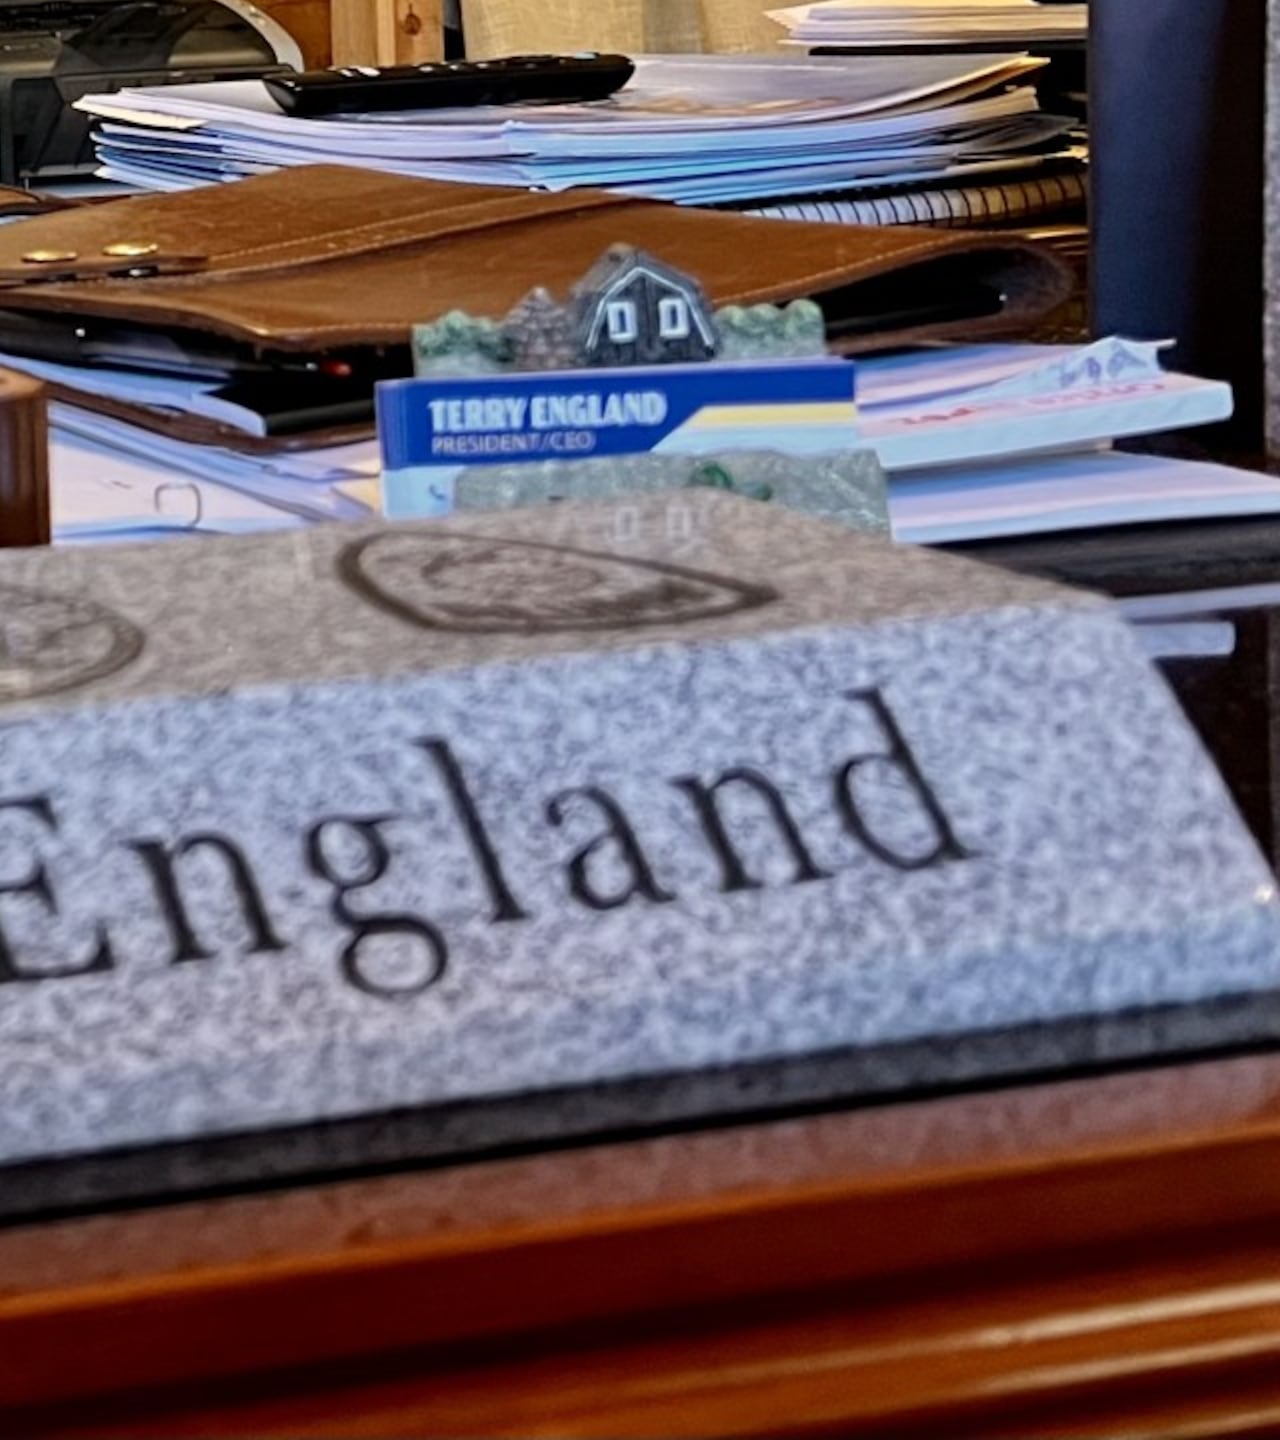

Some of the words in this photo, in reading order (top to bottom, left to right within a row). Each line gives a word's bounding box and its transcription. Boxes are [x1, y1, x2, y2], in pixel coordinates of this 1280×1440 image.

[428, 395, 528, 433] TERRY
[529, 391, 668, 429] ENGLAND
[432, 430, 597, 455] PRESIDENT/CEO
